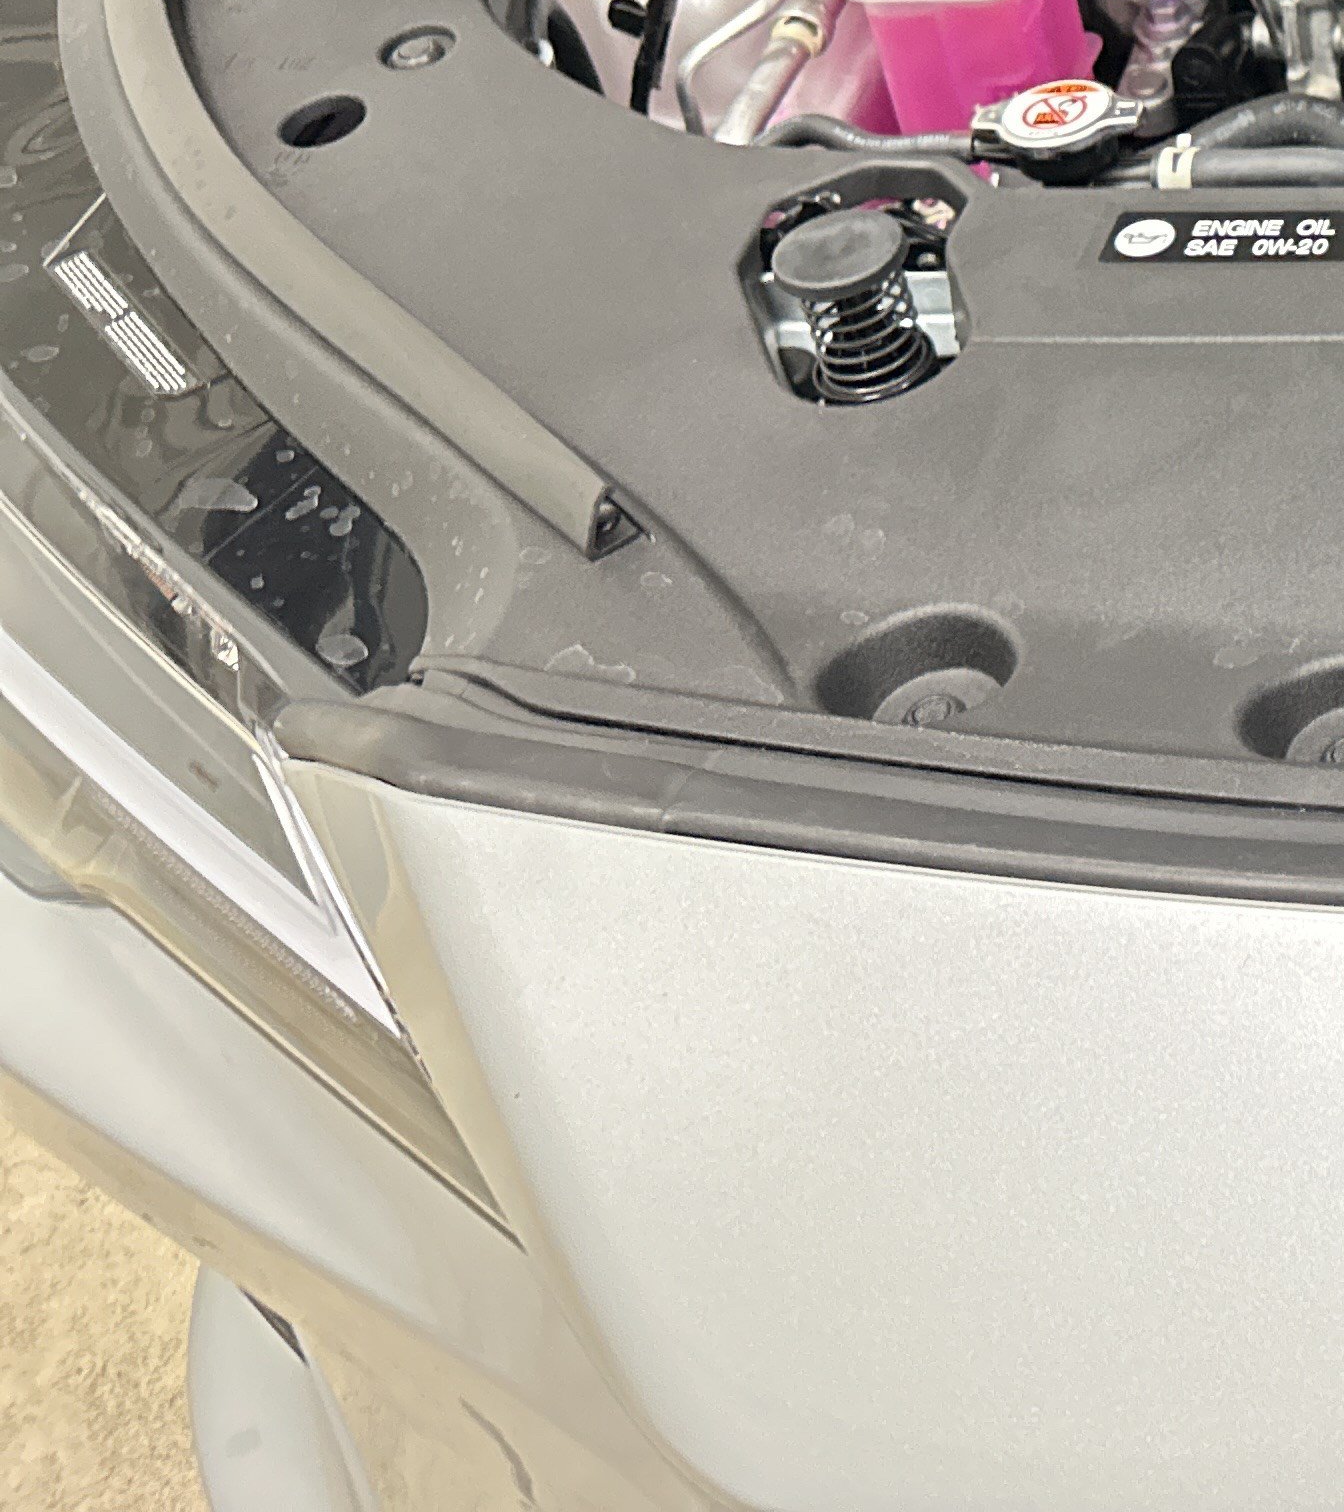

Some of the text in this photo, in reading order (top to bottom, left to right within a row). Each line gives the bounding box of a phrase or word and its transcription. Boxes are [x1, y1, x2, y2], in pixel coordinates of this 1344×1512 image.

[1192, 219, 1336, 237] ENGINE OIL
[1184, 238, 1329, 257] SAE 0W-20
